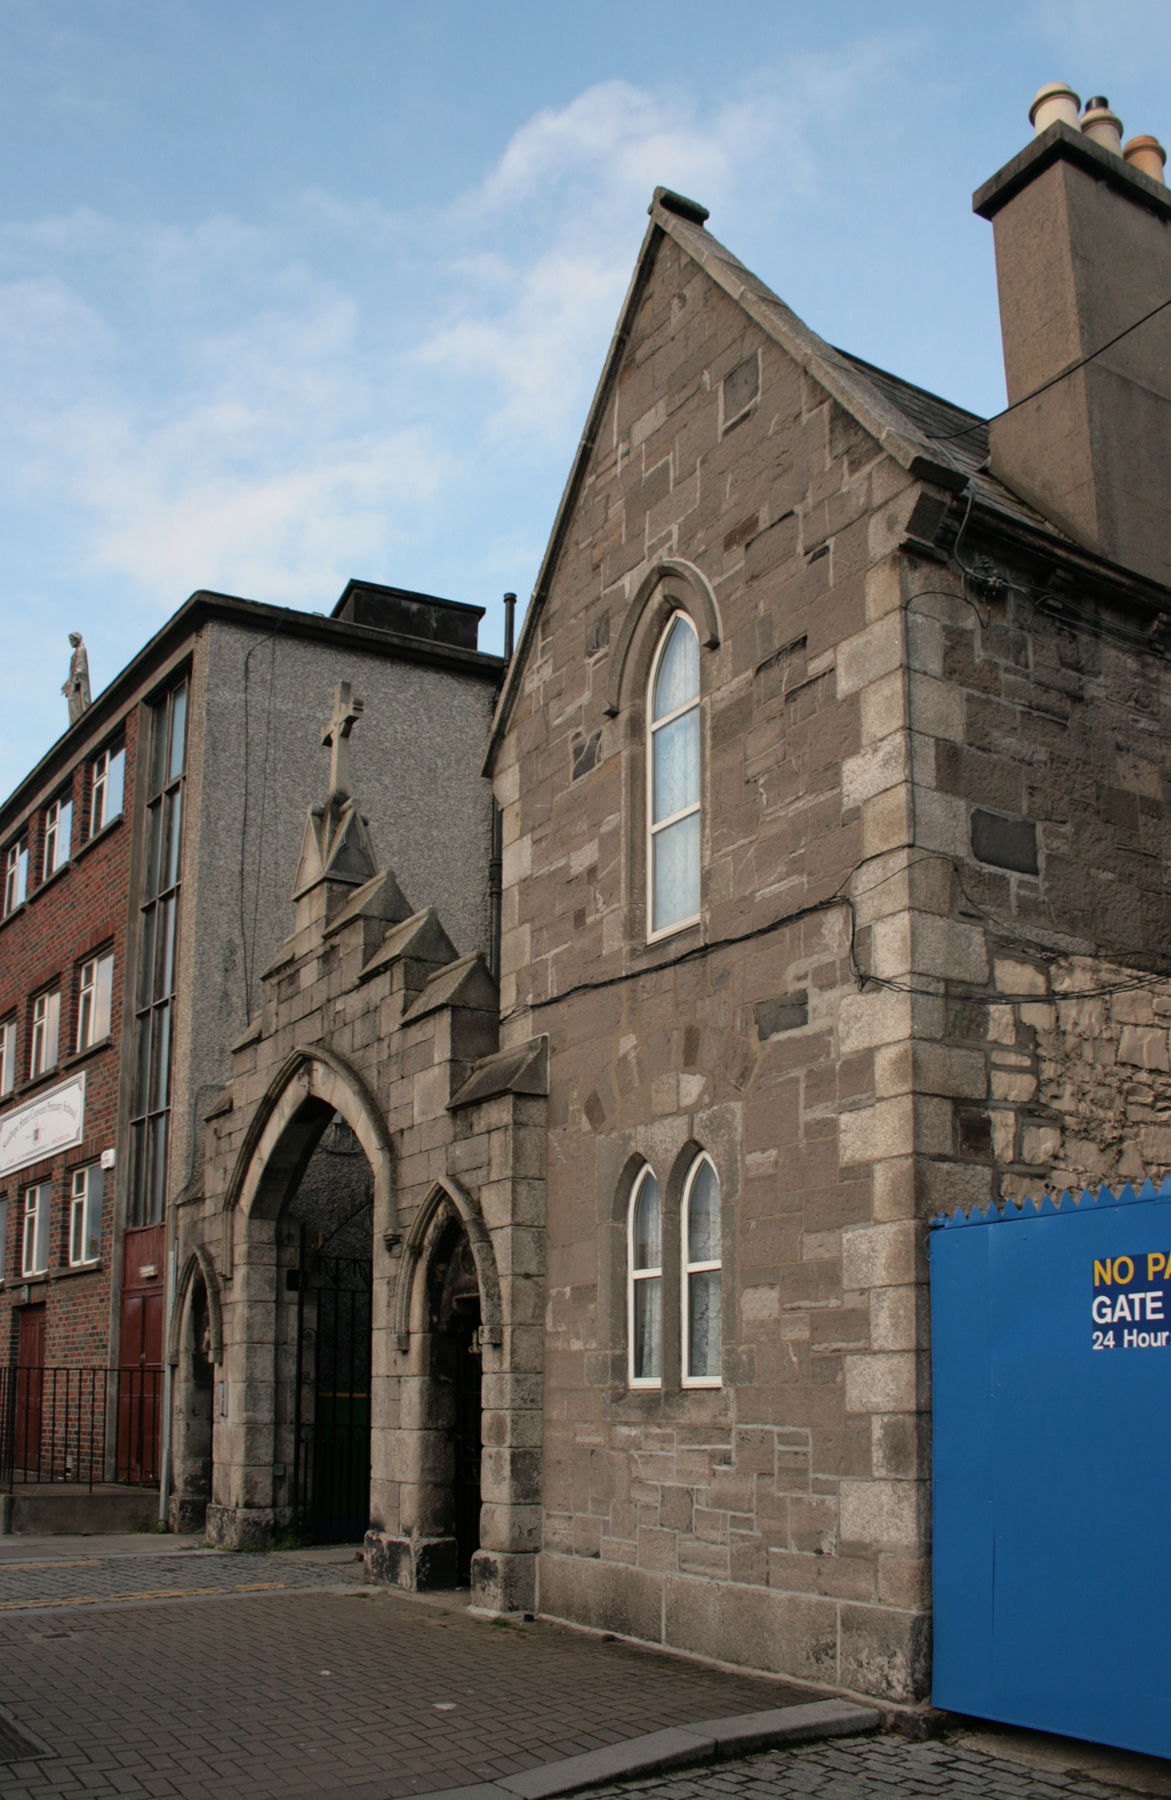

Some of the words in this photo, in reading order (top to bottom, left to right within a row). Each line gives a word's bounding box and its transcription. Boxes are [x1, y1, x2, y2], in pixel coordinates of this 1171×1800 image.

[47, 1100, 63, 1115] Primary
[63, 1100, 78, 1120] School
[1093, 1256, 1134, 1287] NO
[1092, 1290, 1165, 1324] GATE
[1092, 1330, 1115, 1350] 24
